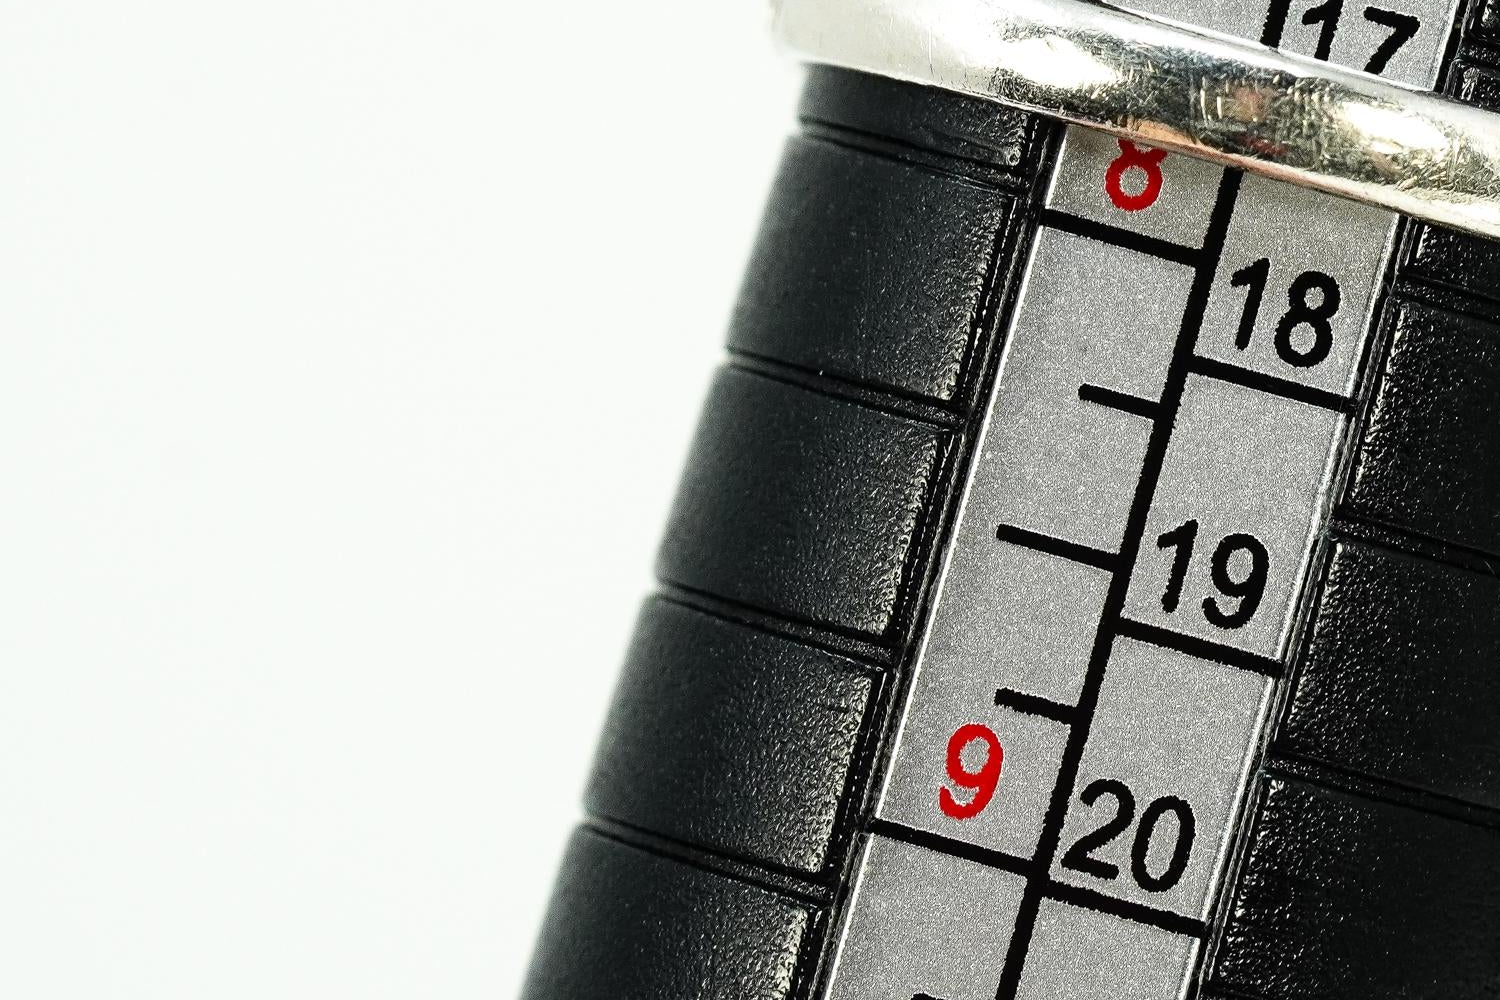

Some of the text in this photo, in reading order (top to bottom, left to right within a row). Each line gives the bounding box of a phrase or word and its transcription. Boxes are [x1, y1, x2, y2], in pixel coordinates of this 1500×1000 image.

[1105, 138, 1165, 212] 8
[1231, 258, 1341, 369] 18
[1157, 519, 1269, 630] 19
[939, 724, 1003, 820] 9
[1060, 779, 1196, 893] 20
